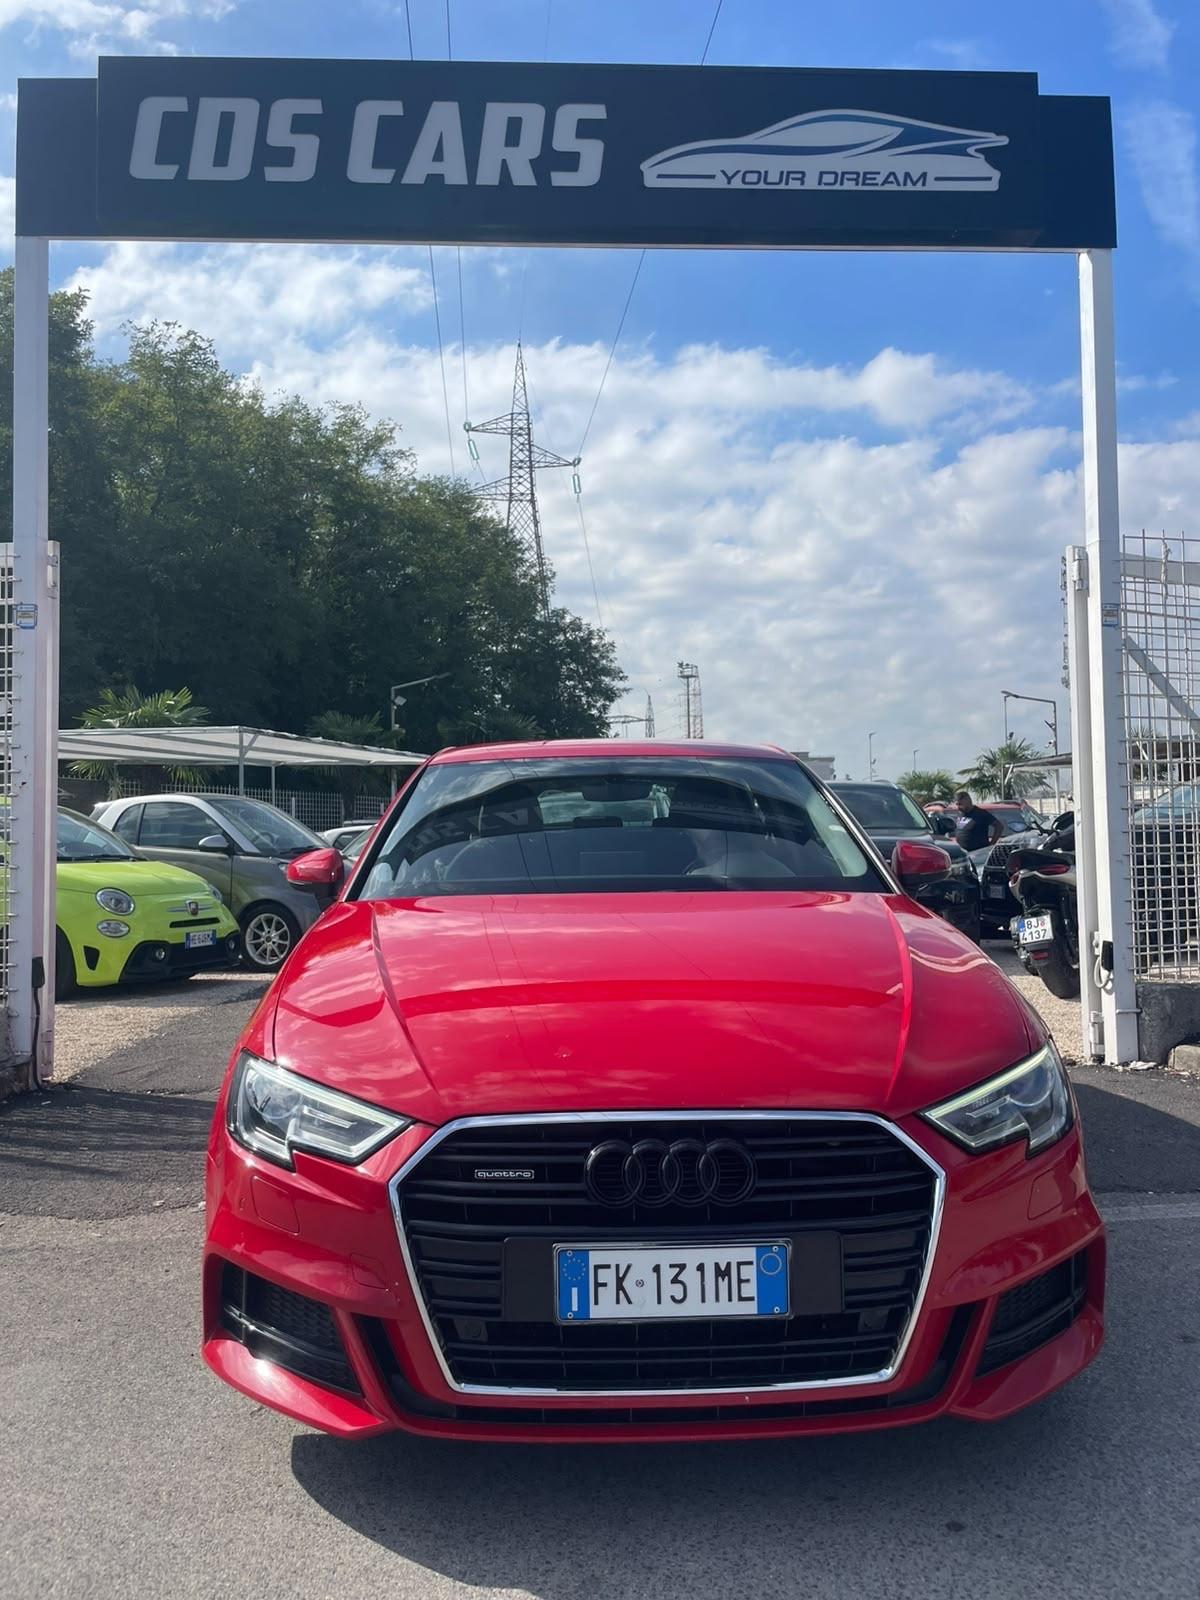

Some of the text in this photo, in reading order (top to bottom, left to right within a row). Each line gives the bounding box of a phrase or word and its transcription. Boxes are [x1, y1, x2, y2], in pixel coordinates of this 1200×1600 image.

[129, 96, 608, 187] CDS CARS
[719, 169, 928, 188] YOUR DREAM
[477, 1171, 532, 1179] quattro
[593, 1260, 756, 1306] FK 131ME
